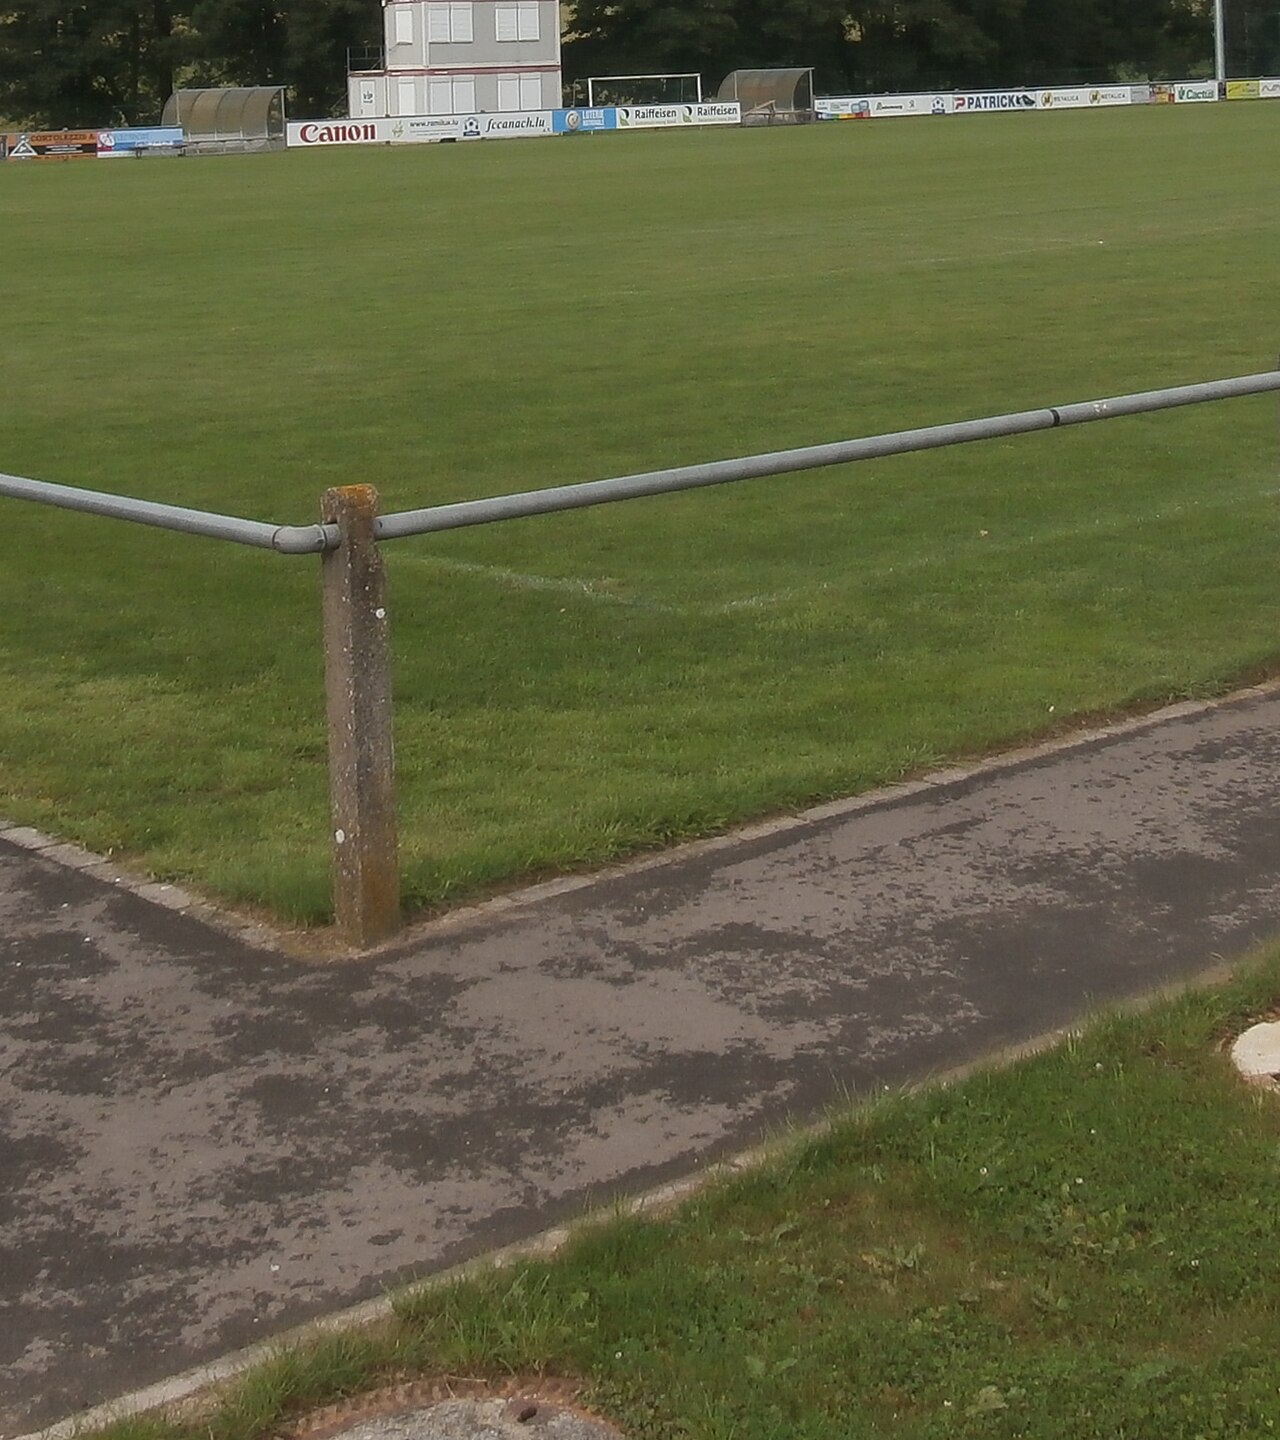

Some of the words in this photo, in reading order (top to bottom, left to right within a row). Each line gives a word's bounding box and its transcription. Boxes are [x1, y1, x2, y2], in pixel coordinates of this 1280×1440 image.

[1186, 88, 1215, 100] Cactus
[967, 95, 1016, 110] PATRICK
[634, 108, 677, 119] Raiffeisen
[697, 106, 738, 117] Raiffeisen
[485, 116, 546, 133] fccanach.lu
[300, 124, 376, 143] Canon
